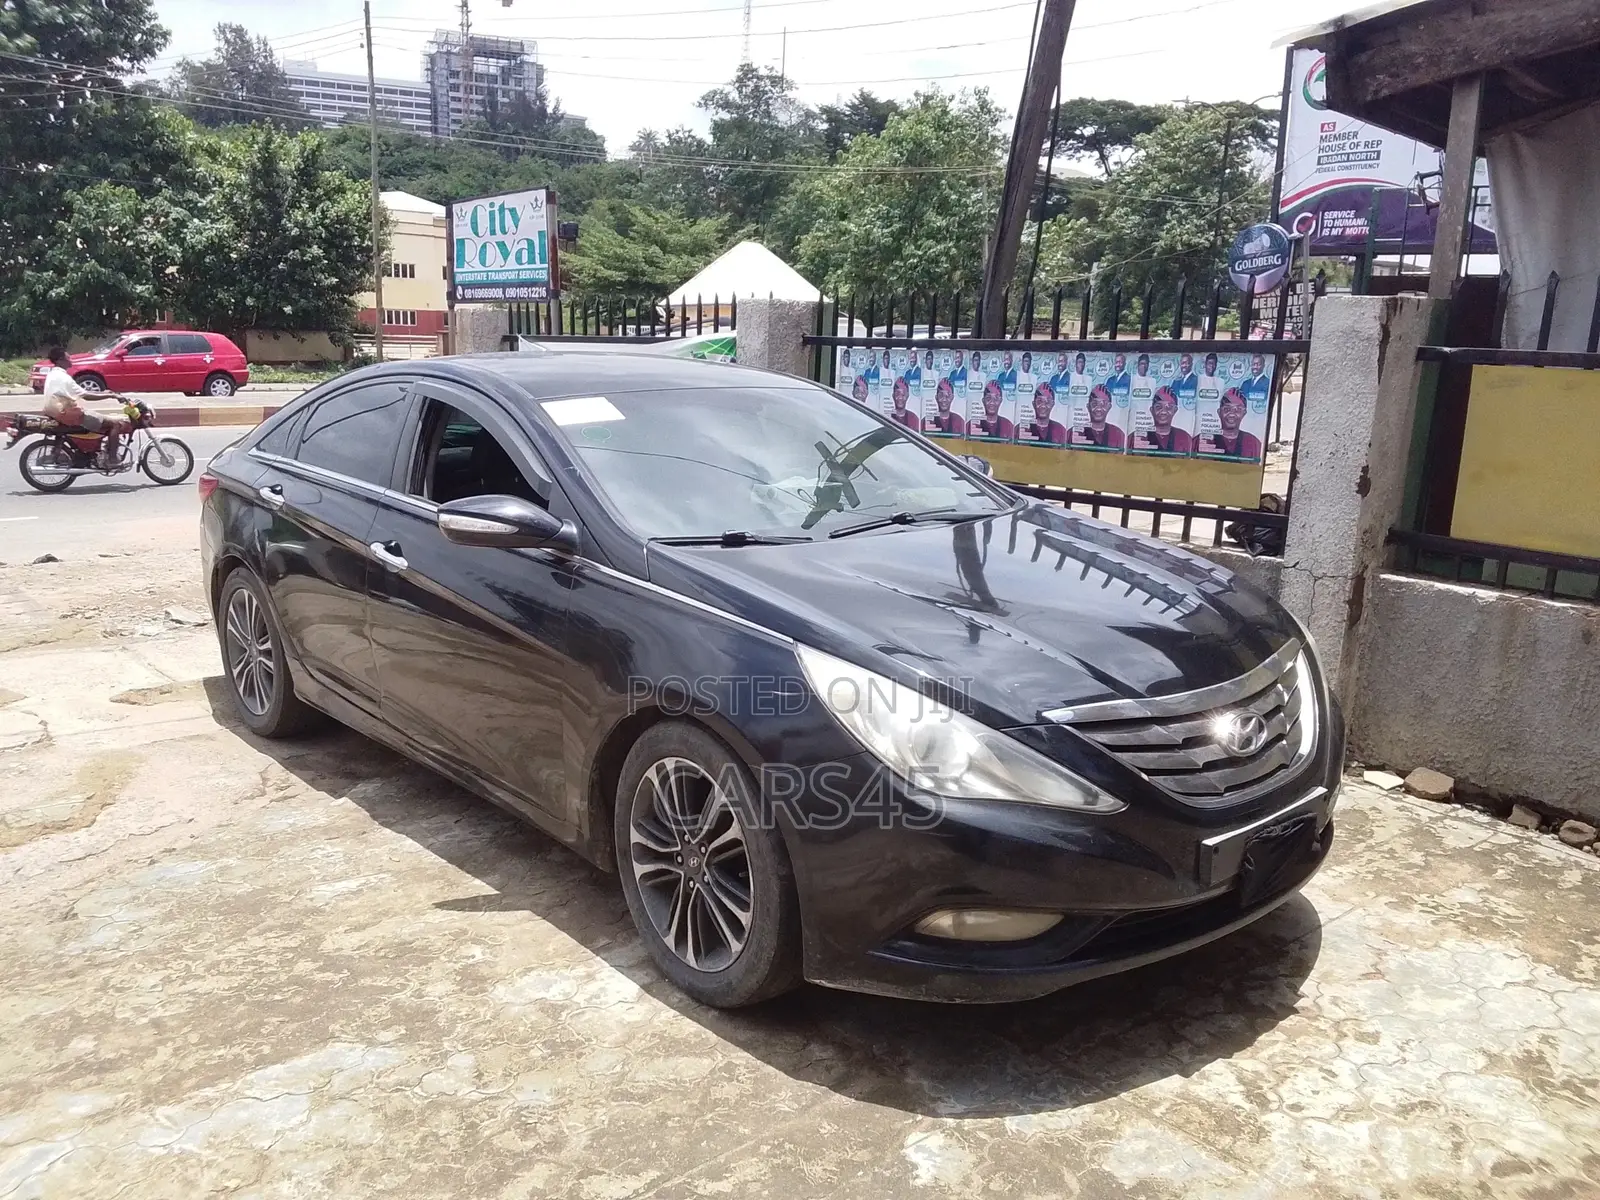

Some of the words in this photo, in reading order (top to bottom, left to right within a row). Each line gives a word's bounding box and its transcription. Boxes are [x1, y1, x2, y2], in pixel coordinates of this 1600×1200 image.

[1323, 123, 1334, 132] AS
[1320, 131, 1359, 143] MEMBER
[1318, 142, 1347, 154] HOUSE
[1349, 141, 1361, 151] OF
[1363, 139, 1383, 150] REP
[1320, 153, 1348, 164] IBADAN
[1348, 151, 1378, 161] NORTH
[1315, 164, 1337, 174] FEDERAL
[1337, 162, 1380, 172] CONSTITUENCY
[470, 200, 526, 238] City
[1323, 209, 1356, 219] SERVICE
[1323, 219, 1333, 228] TO
[1322, 228, 1331, 237] IS
[1331, 227, 1343, 236] MY
[455, 230, 548, 269] Royal
[1235, 253, 1282, 271] GOLDBERG
[488, 270, 519, 280] TRANSPORT
